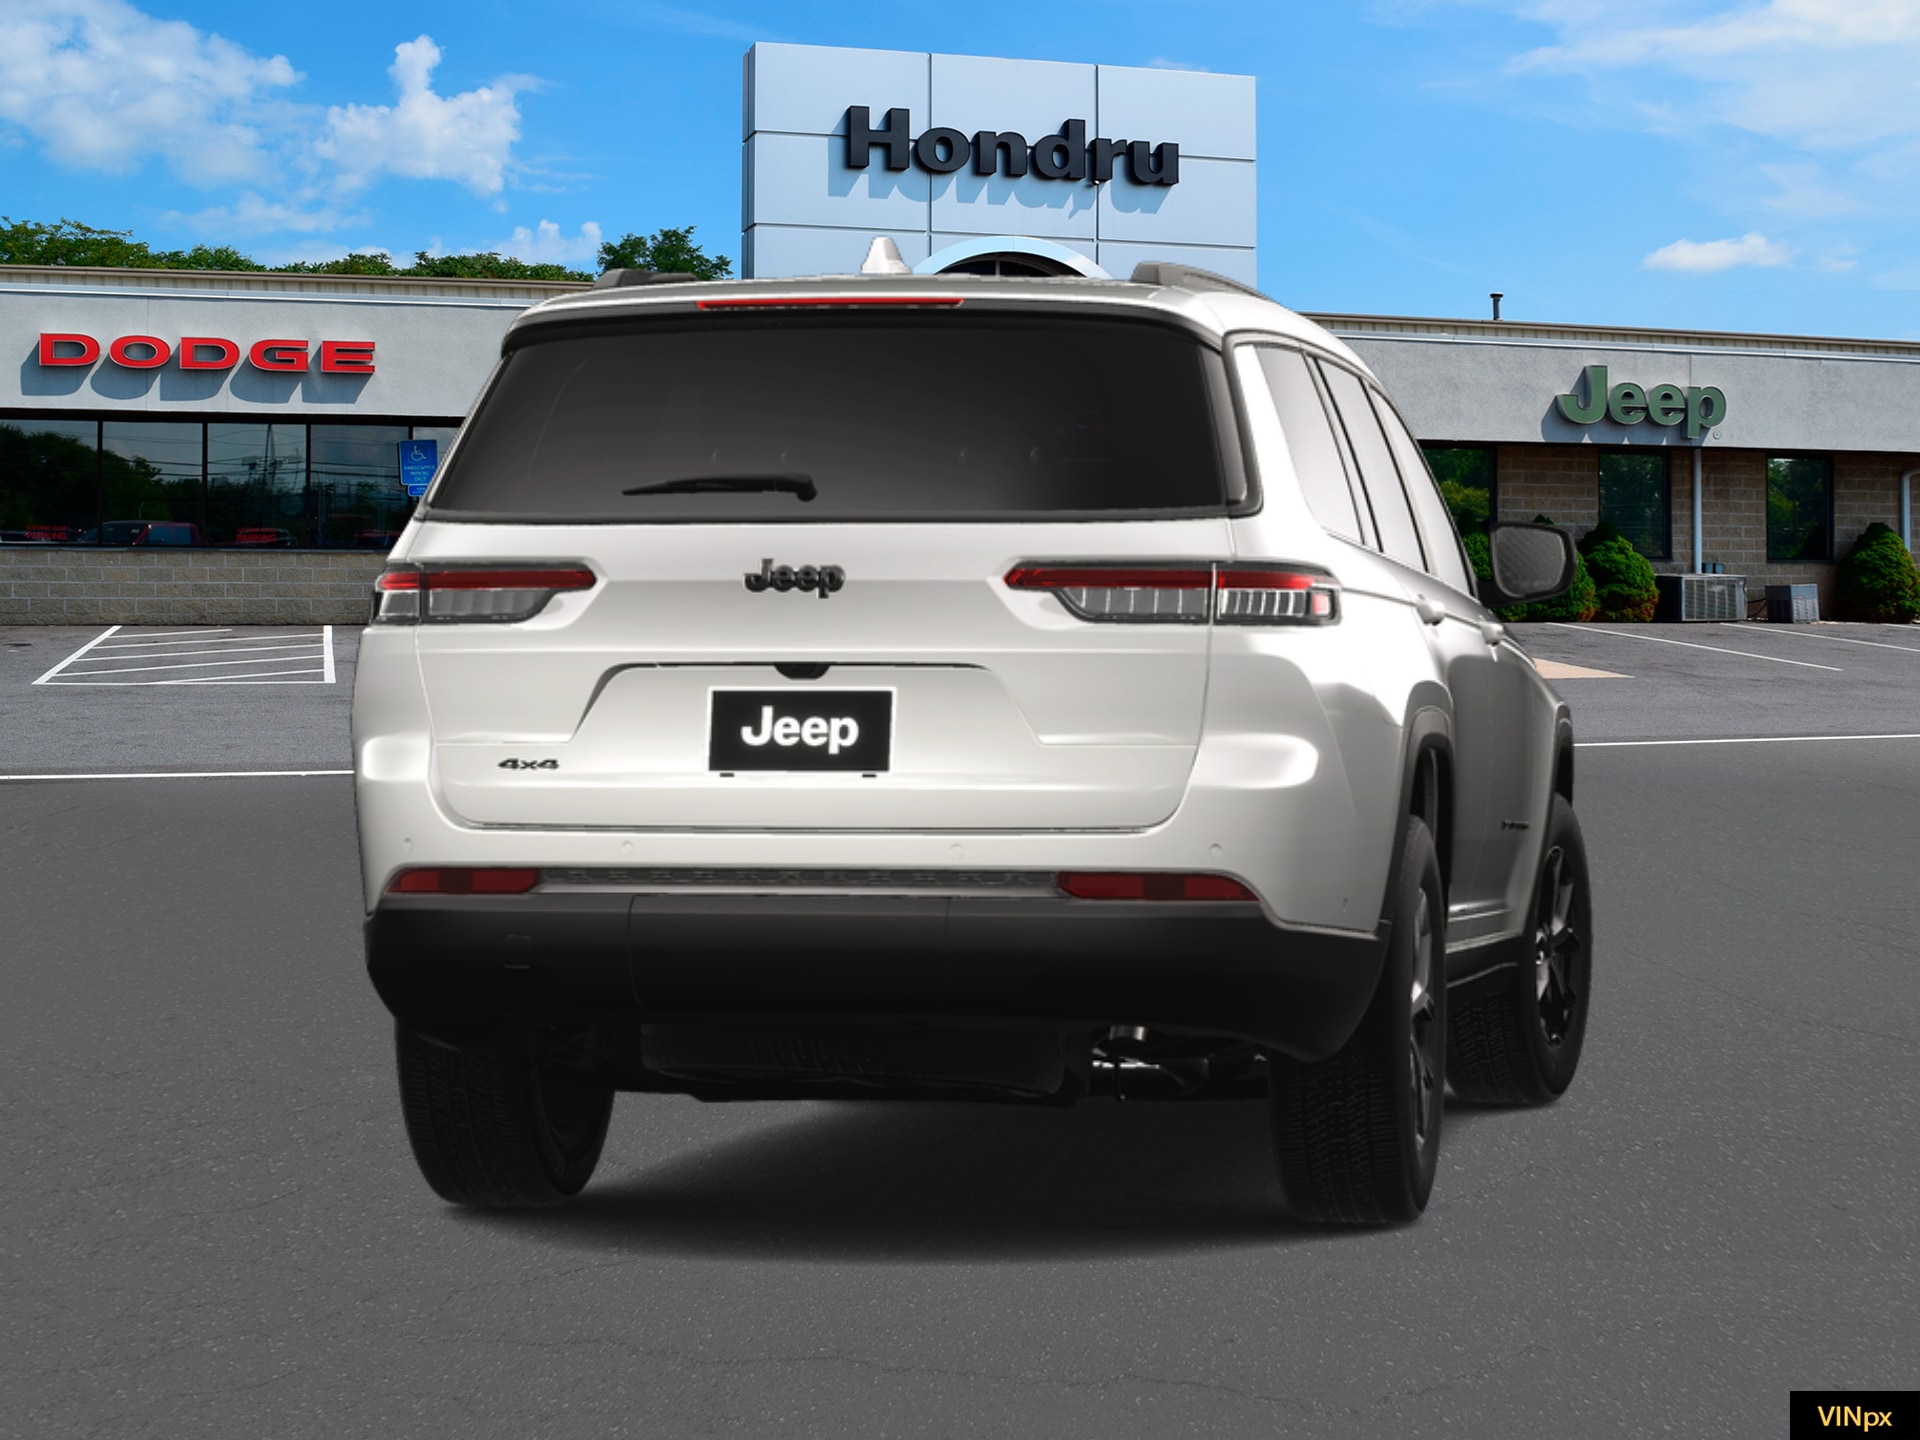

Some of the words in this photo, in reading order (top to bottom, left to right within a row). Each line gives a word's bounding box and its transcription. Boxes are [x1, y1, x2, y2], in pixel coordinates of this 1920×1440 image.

[846, 105, 1180, 185] Hondru
[38, 333, 376, 374] DODGE
[1556, 365, 1727, 439] Jeep
[26, 532, 68, 540] PARKING
[744, 558, 845, 599] Jeep
[741, 705, 859, 755] Jeep
[498, 758, 560, 770] 4x4
